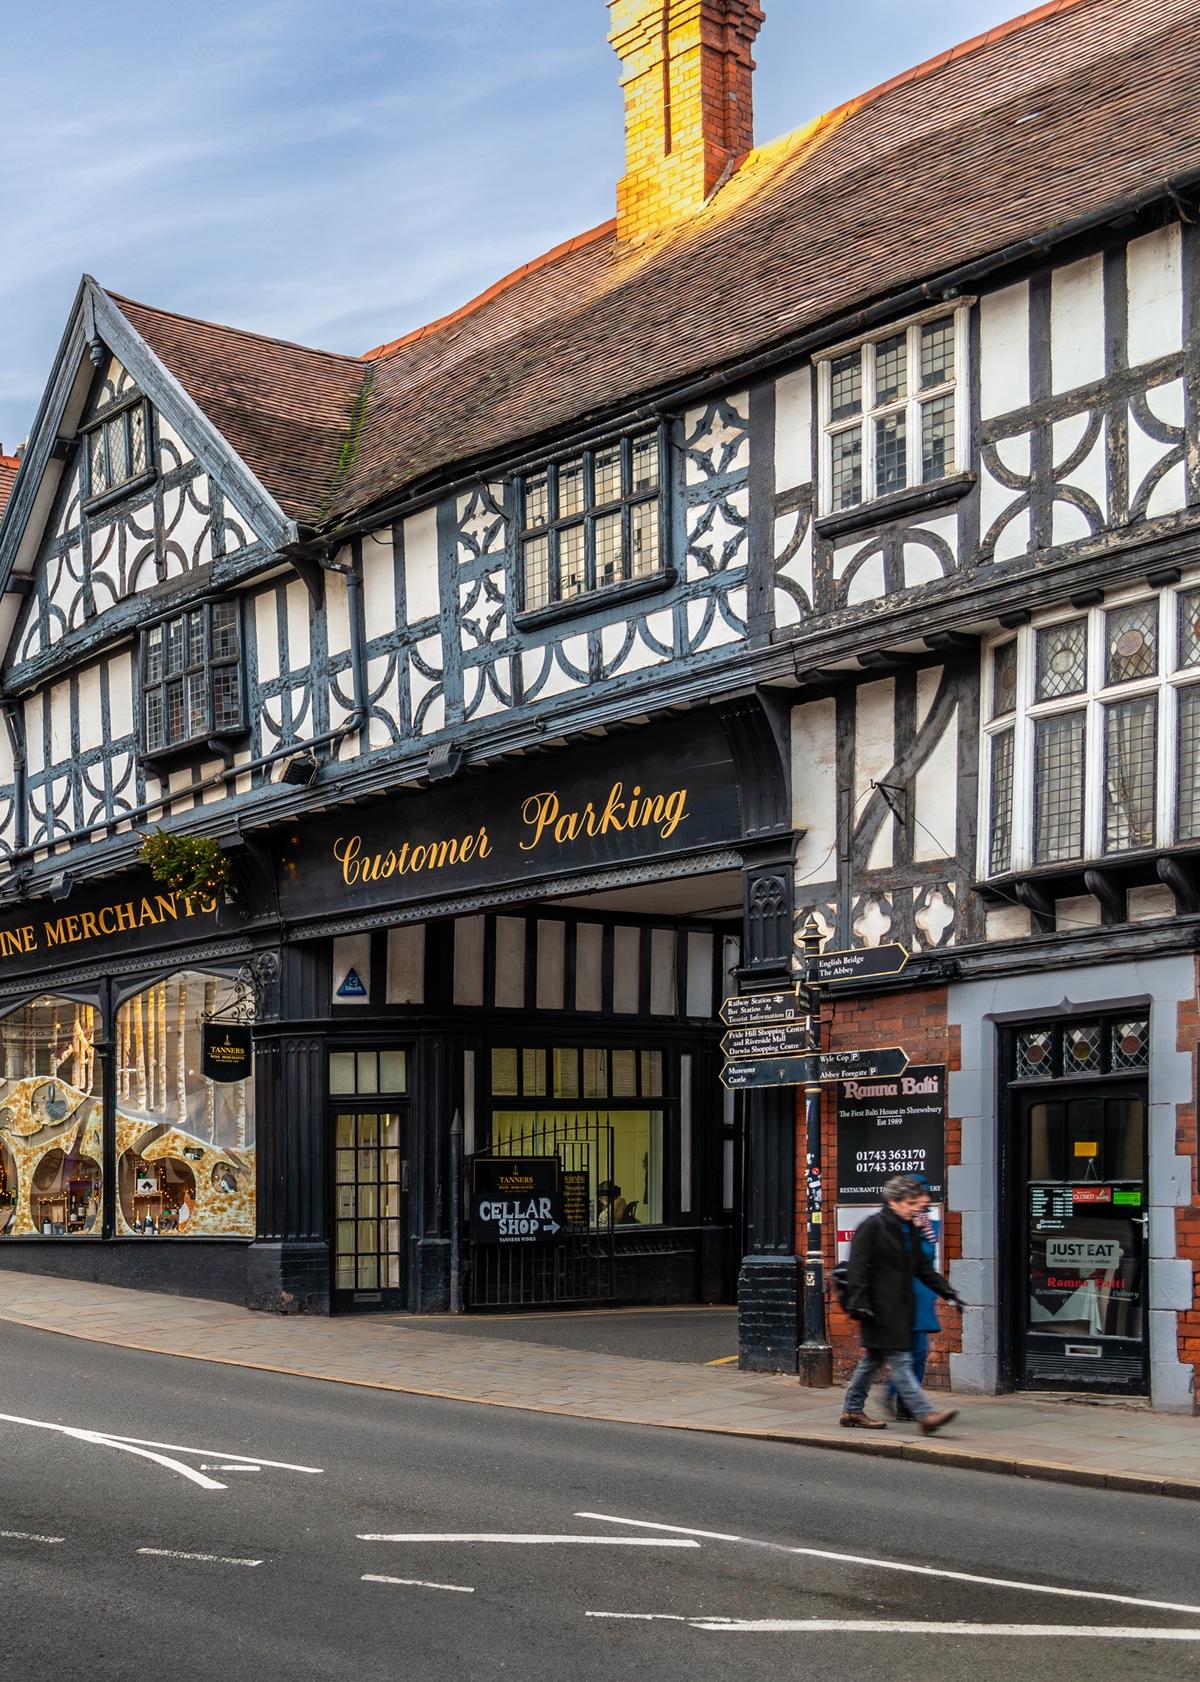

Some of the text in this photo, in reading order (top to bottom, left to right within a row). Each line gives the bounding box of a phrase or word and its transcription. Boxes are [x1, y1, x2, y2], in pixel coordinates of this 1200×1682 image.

[333, 781, 690, 885] Customer Parking
[819, 955, 864, 968] English Bridge
[833, 966, 853, 975] Abbey
[728, 997, 771, 1008] Railway Station
[740, 1006, 761, 1014] Station
[749, 1012, 784, 1021] Information
[757, 1028, 785, 1037] Shopping
[745, 1037, 771, 1045] Riverside
[772, 1034, 786, 1042] Mall
[210, 1046, 245, 1054] TANNERS
[729, 1047, 750, 1055] Darwin
[751, 1045, 779, 1054] Shopping
[819, 1055, 834, 1063] Wyle
[836, 1054, 849, 1063] Cop
[728, 1067, 756, 1075] Museums
[819, 1071, 839, 1080] Abbey
[841, 1069, 867, 1078] Foregate
[728, 1076, 747, 1084] Castle
[843, 1075, 939, 1100] Ramna Balti
[839, 1110, 850, 1118] The
[865, 1108, 878, 1116] Balti
[906, 1106, 942, 1115] Shrewsbury
[877, 1117, 903, 1126] Est 1989
[856, 1149, 926, 1161] 01743 363170
[856, 1161, 925, 1173] 01743 361871
[498, 1176, 534, 1184] TANNERS
[480, 1197, 553, 1221] CELLAR
[498, 1218, 540, 1235] SHOP
[1050, 1243, 1115, 1256] JUST EAT
[1047, 1276, 1088, 1288] Ramna
